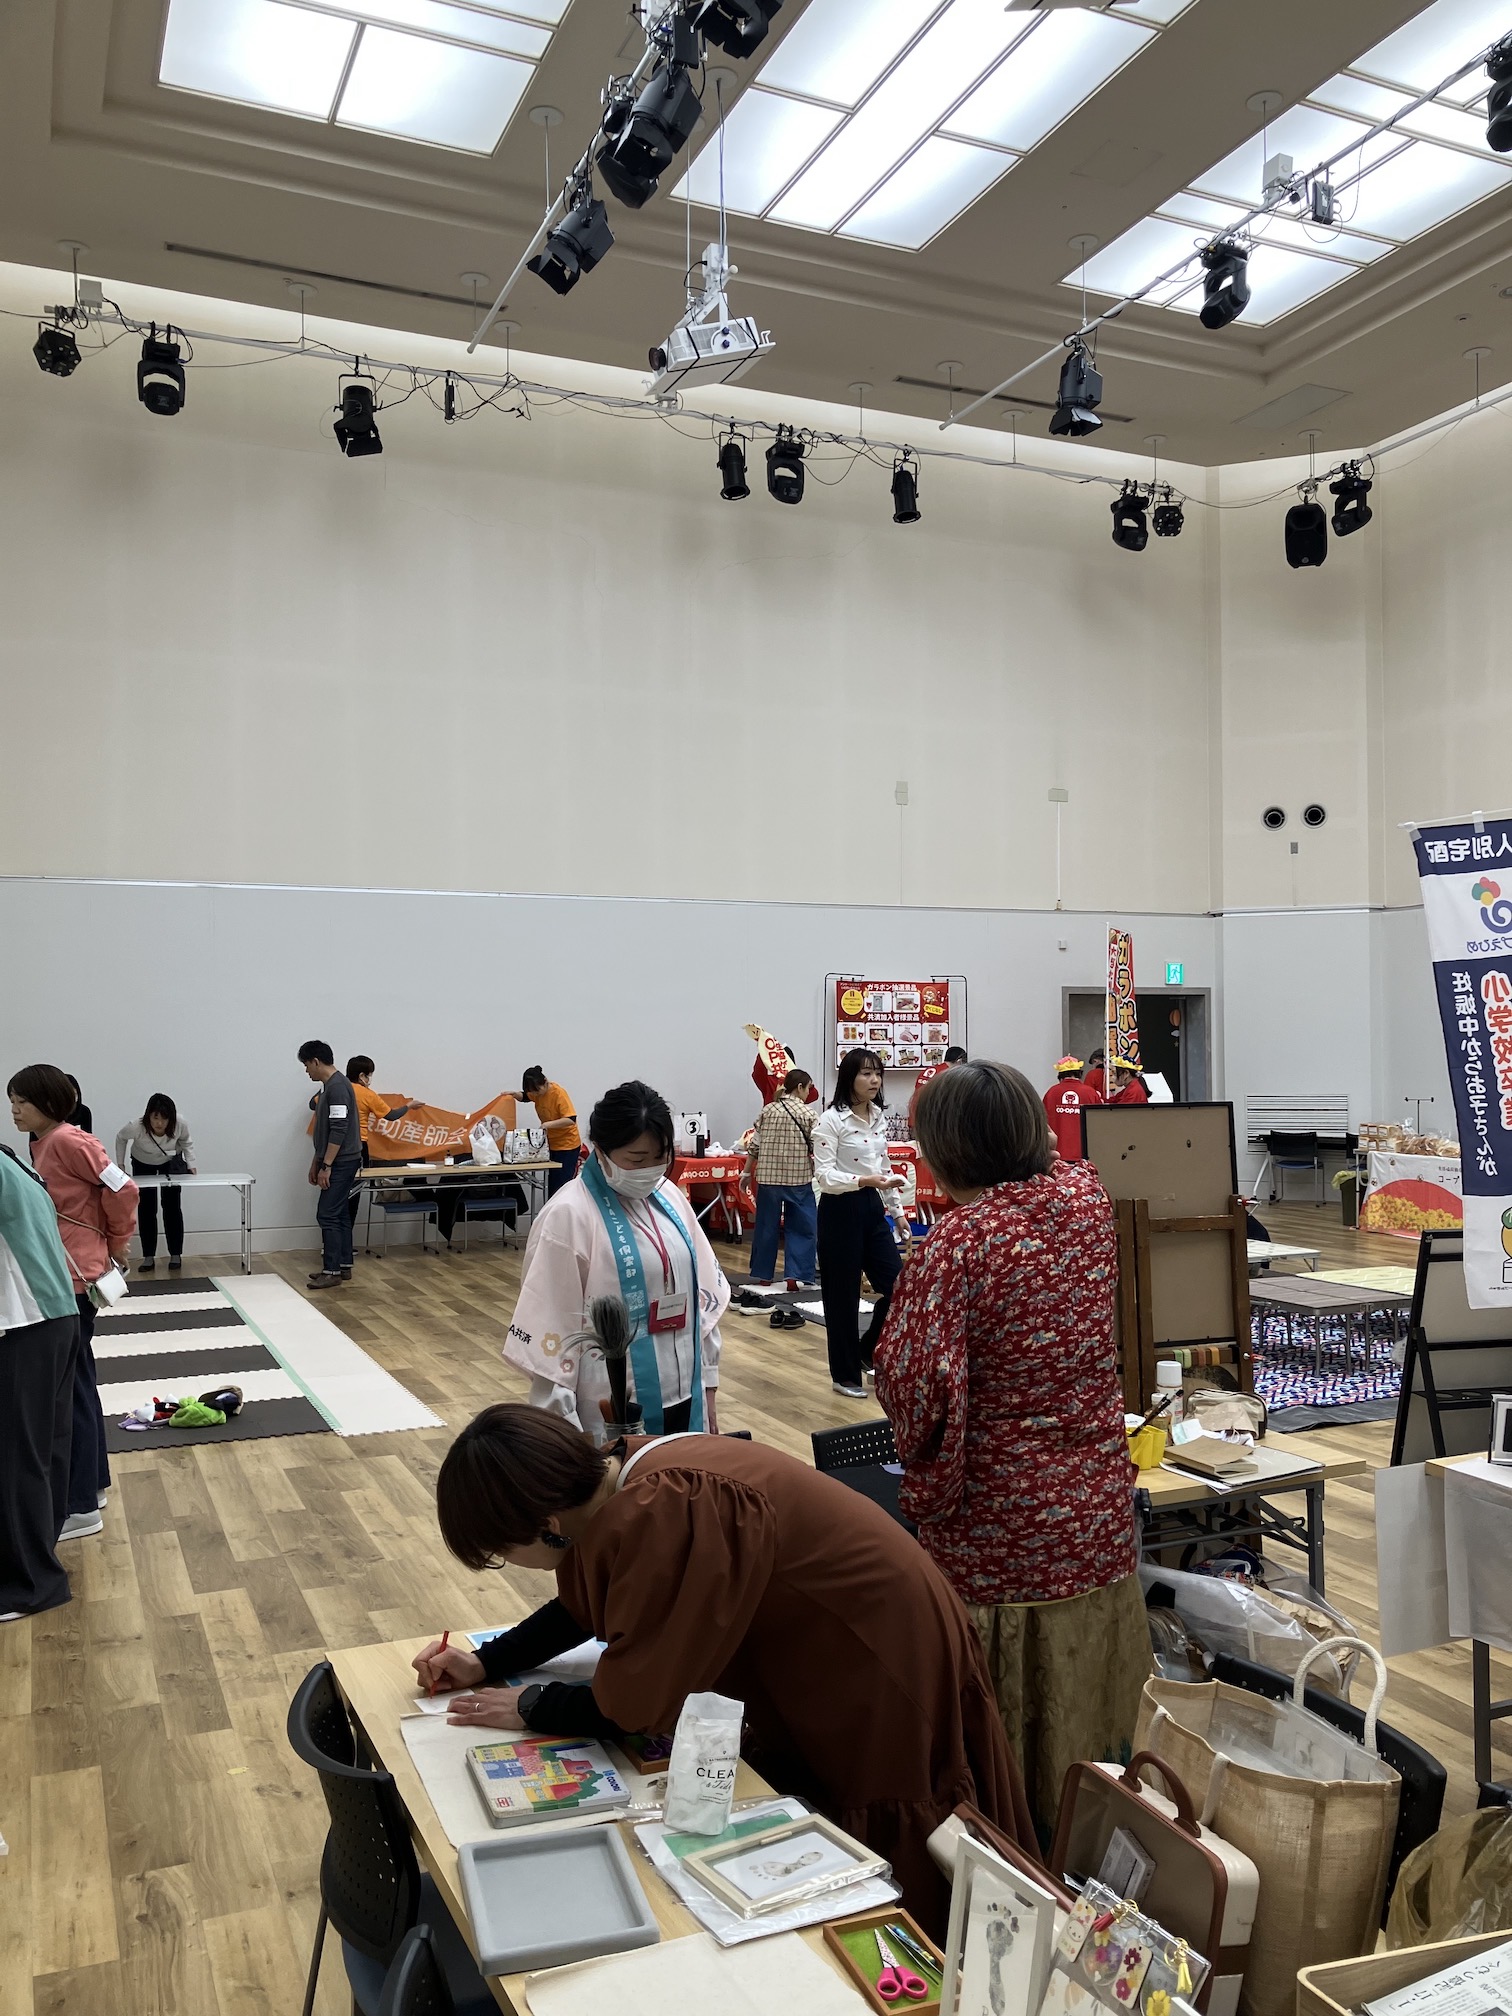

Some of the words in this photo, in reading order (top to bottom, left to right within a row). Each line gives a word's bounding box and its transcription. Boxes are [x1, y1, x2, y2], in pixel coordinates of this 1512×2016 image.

[1118, 933, 1139, 1060] ガラポン
[867, 1013, 919, 1021] 共済加入者様景品
[1438, 1175, 1460, 1185] コープ
